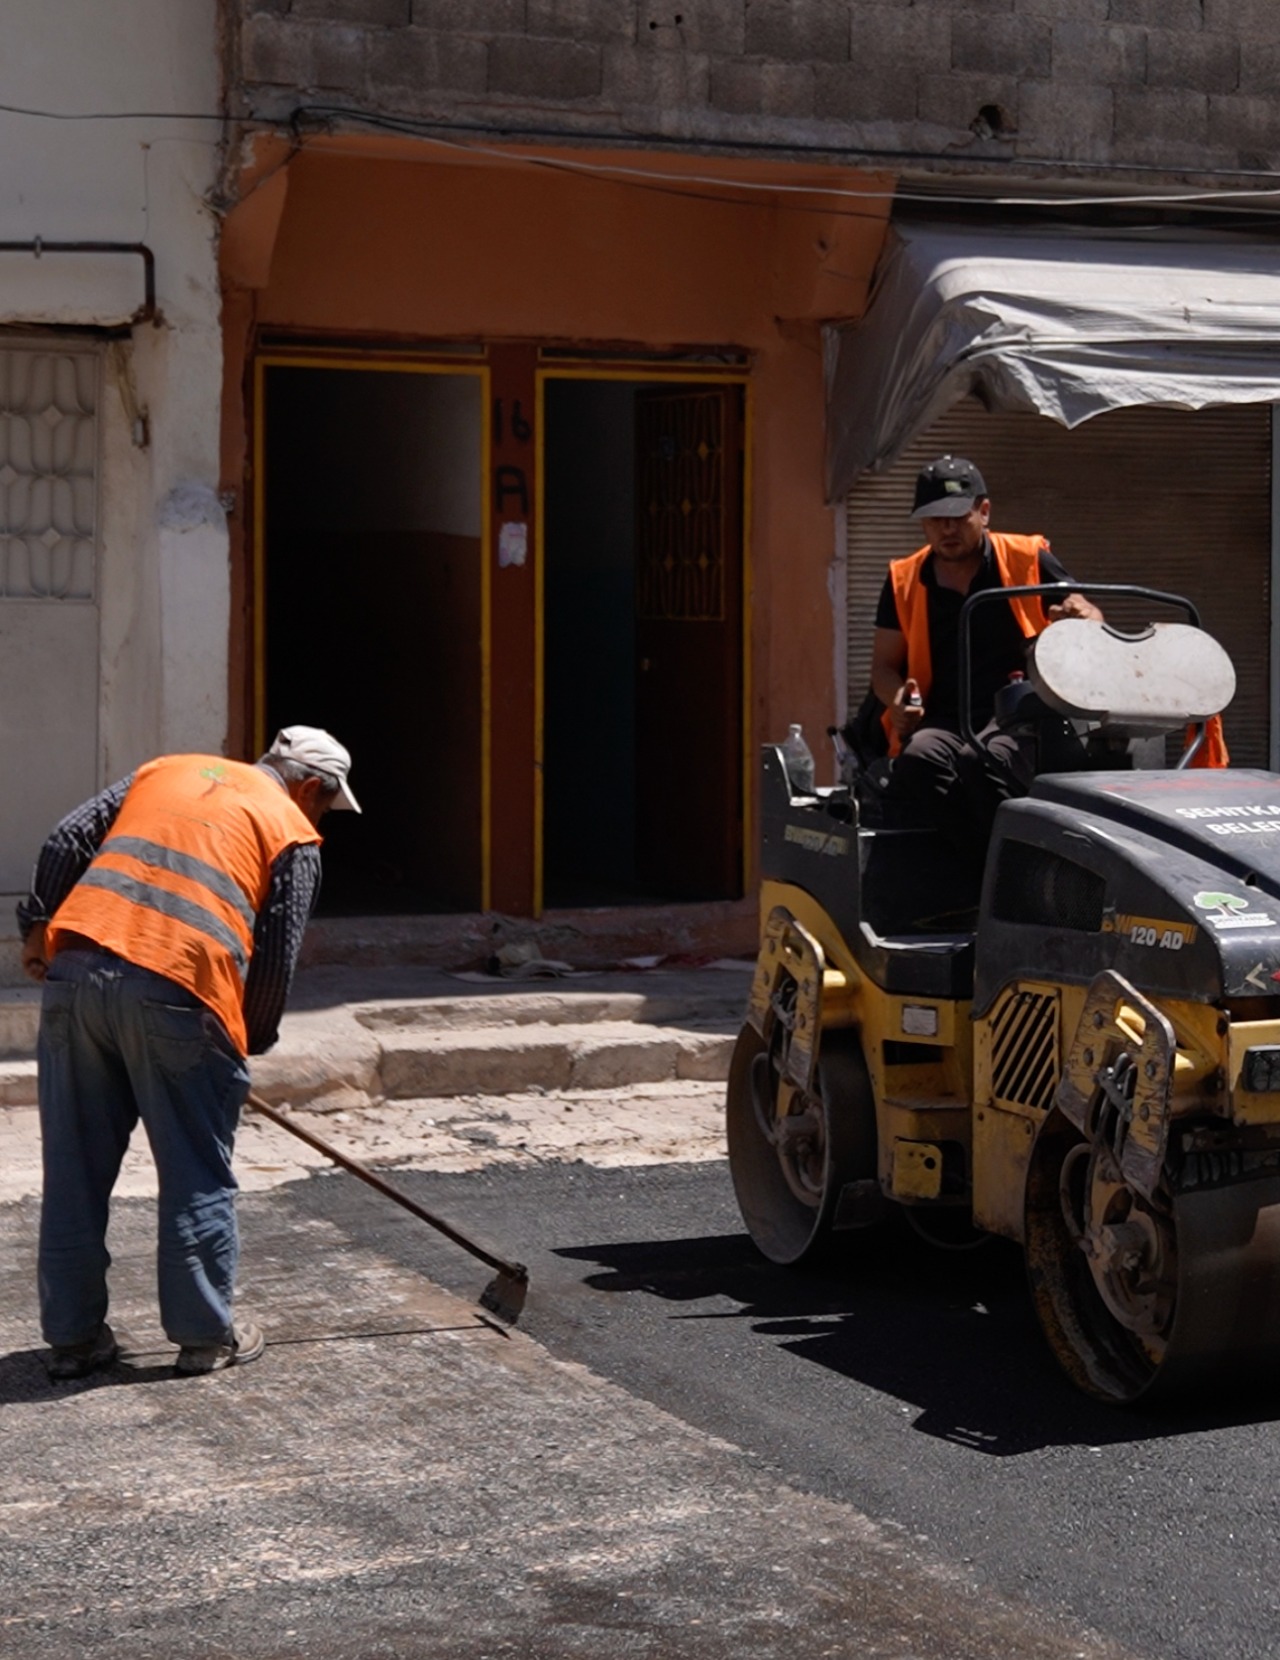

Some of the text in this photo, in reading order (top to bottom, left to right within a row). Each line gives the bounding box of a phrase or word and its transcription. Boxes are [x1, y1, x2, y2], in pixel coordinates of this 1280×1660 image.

[495, 464, 529, 515] A
[1130, 926, 1157, 946] 120
[1159, 931, 1184, 950] AD
